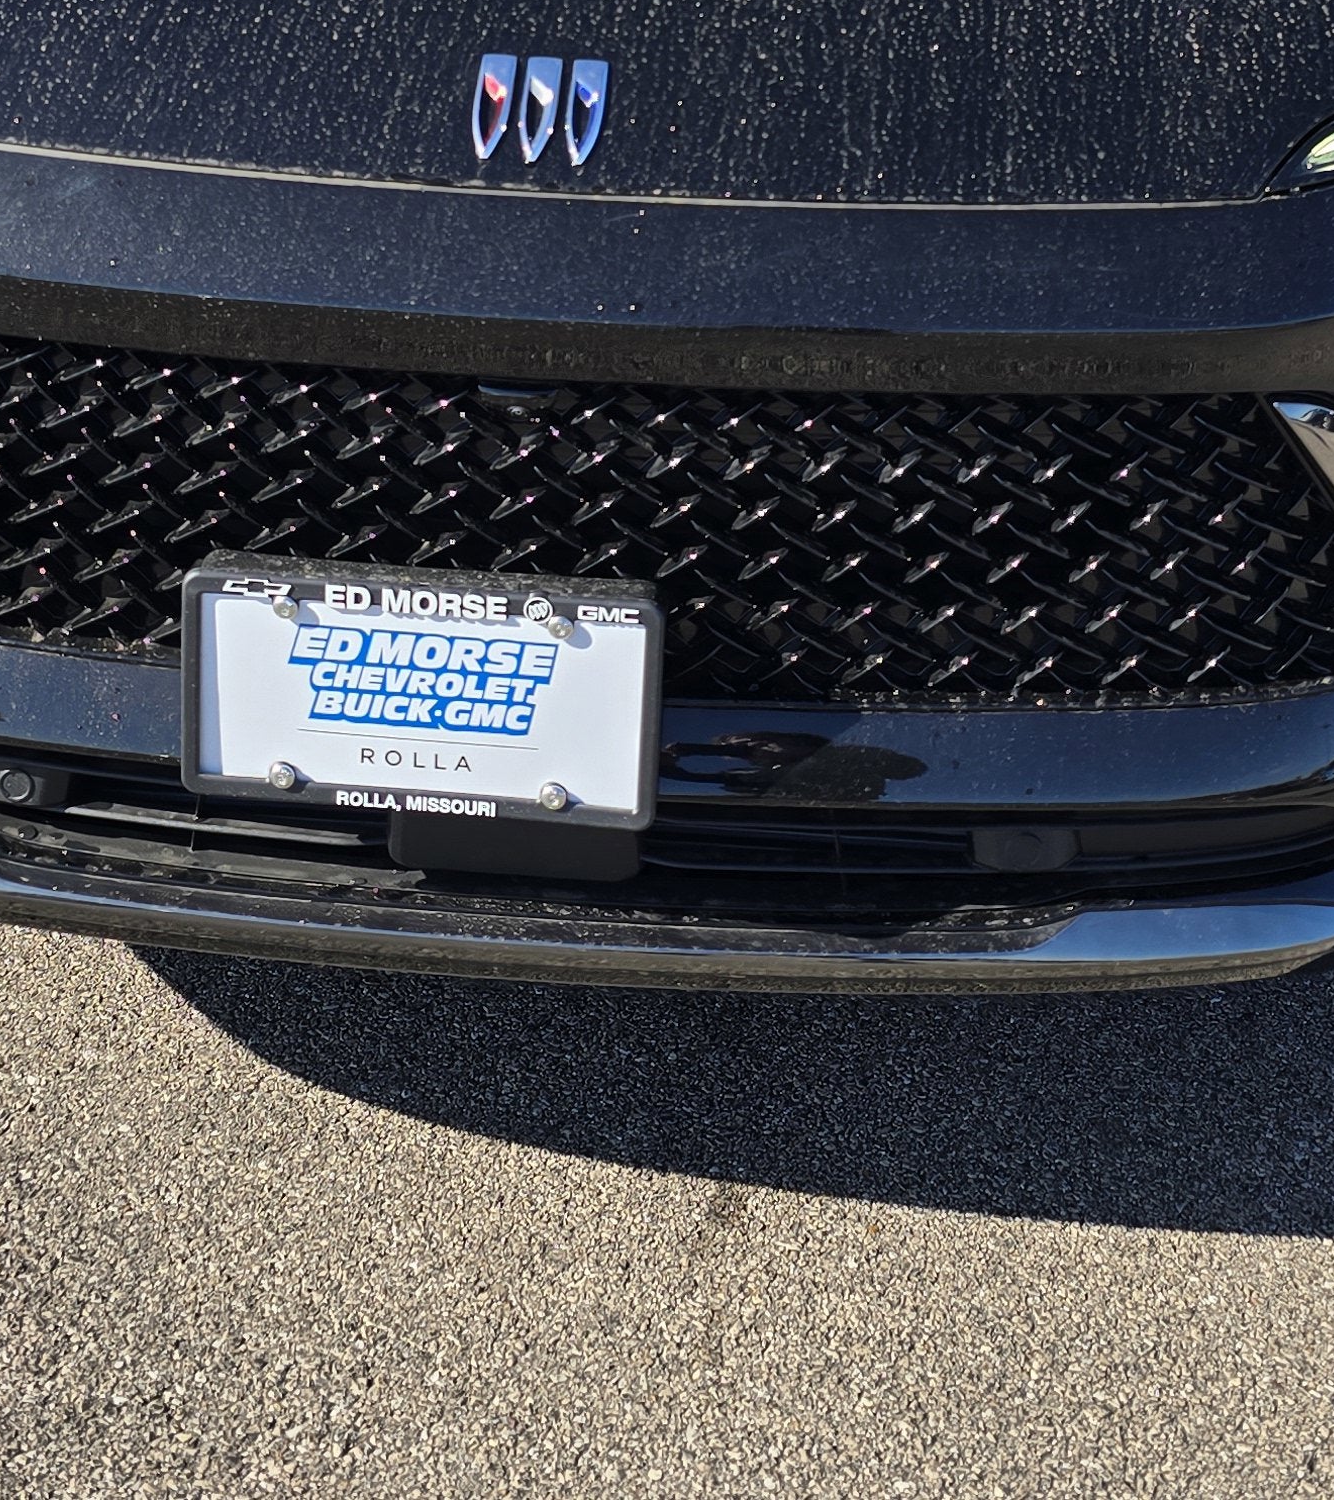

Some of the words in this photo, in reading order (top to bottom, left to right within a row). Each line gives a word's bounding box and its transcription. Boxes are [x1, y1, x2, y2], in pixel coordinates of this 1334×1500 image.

[325, 584, 371, 611] ED
[382, 588, 508, 621] MORSE
[577, 605, 640, 624] GMC
[292, 626, 364, 661] ED
[366, 632, 557, 677] MORSE
[311, 662, 535, 703] CHEVROLET
[360, 747, 472, 773] ROLLA
[336, 790, 402, 812] ROLLA,
[406, 795, 496, 818] MISSOURI
